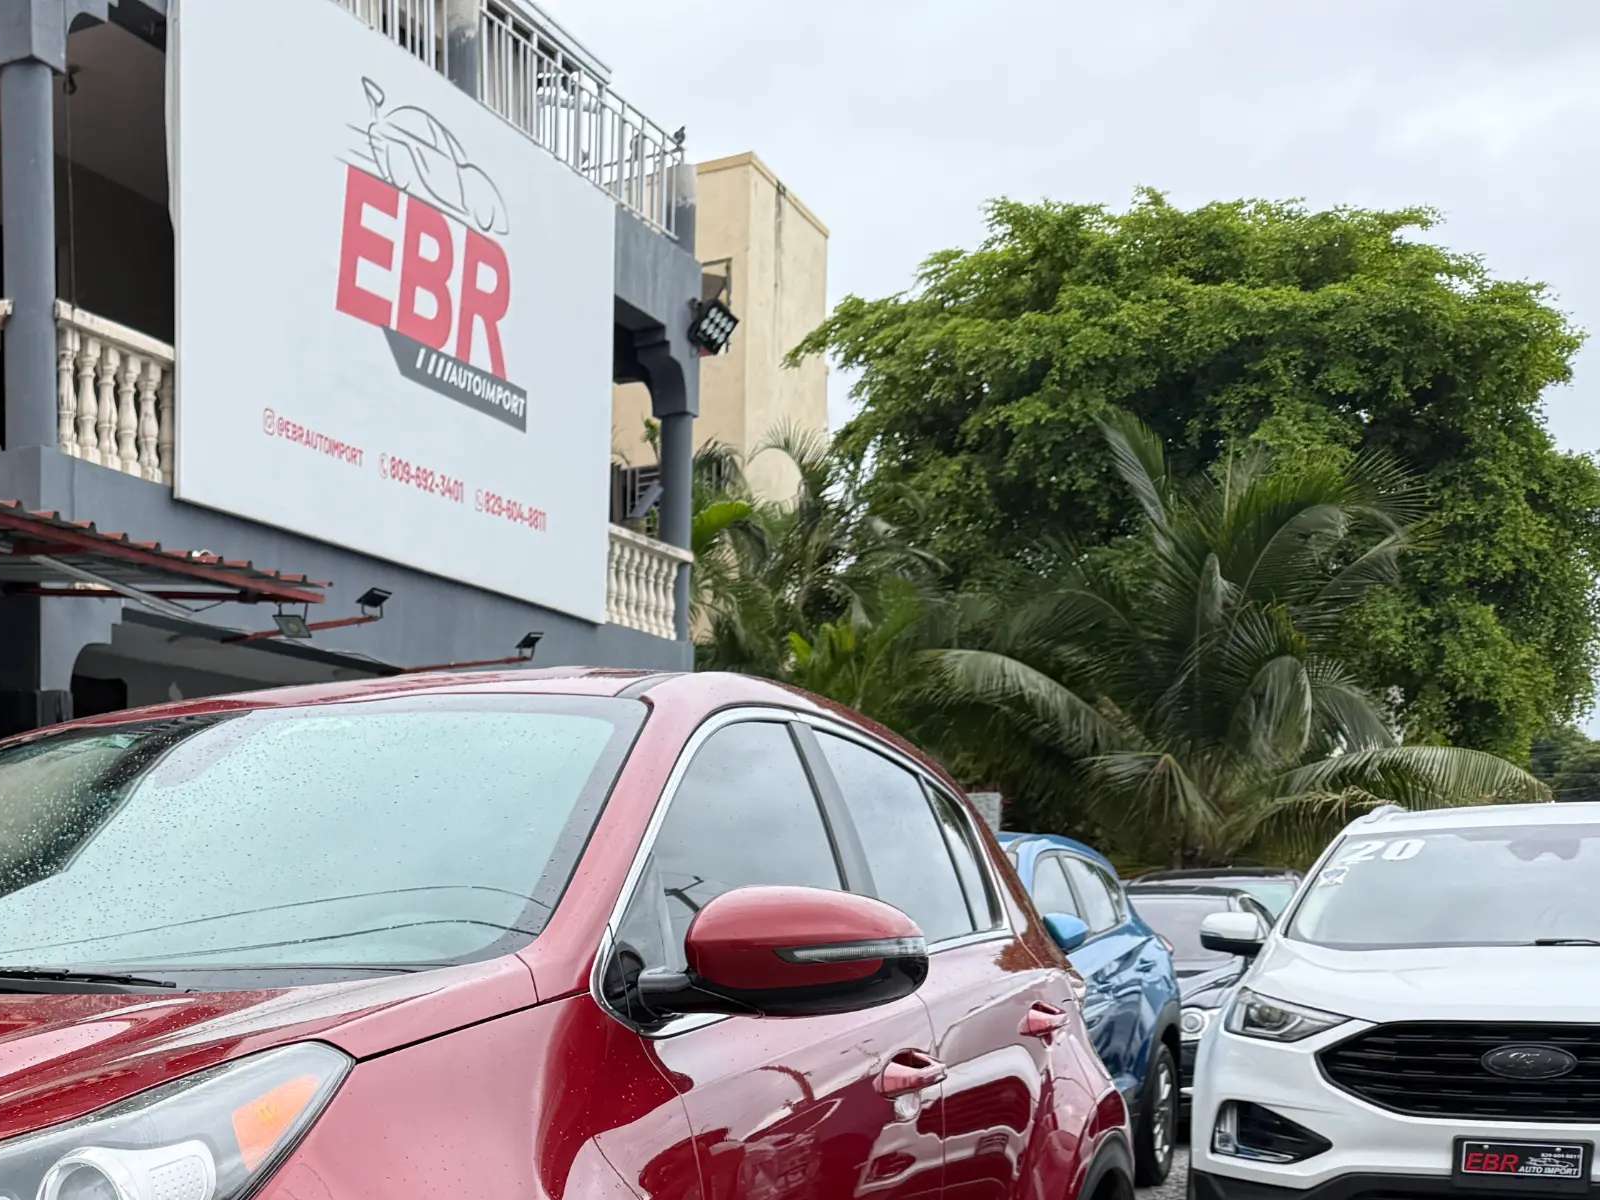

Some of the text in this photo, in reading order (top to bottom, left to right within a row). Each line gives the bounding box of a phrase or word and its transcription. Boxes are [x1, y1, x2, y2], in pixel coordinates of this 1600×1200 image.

[335, 163, 510, 381] EBR
[448, 364, 525, 418] AUTOIMPORT
[277, 416, 364, 468] @EBRAUTOIMPORT
[390, 456, 464, 503] 809-692-3401
[1338, 839, 1426, 864] 20
[1465, 1152, 1520, 1173] EBR
[1518, 1165, 1579, 1176] AUTO IMPORT
